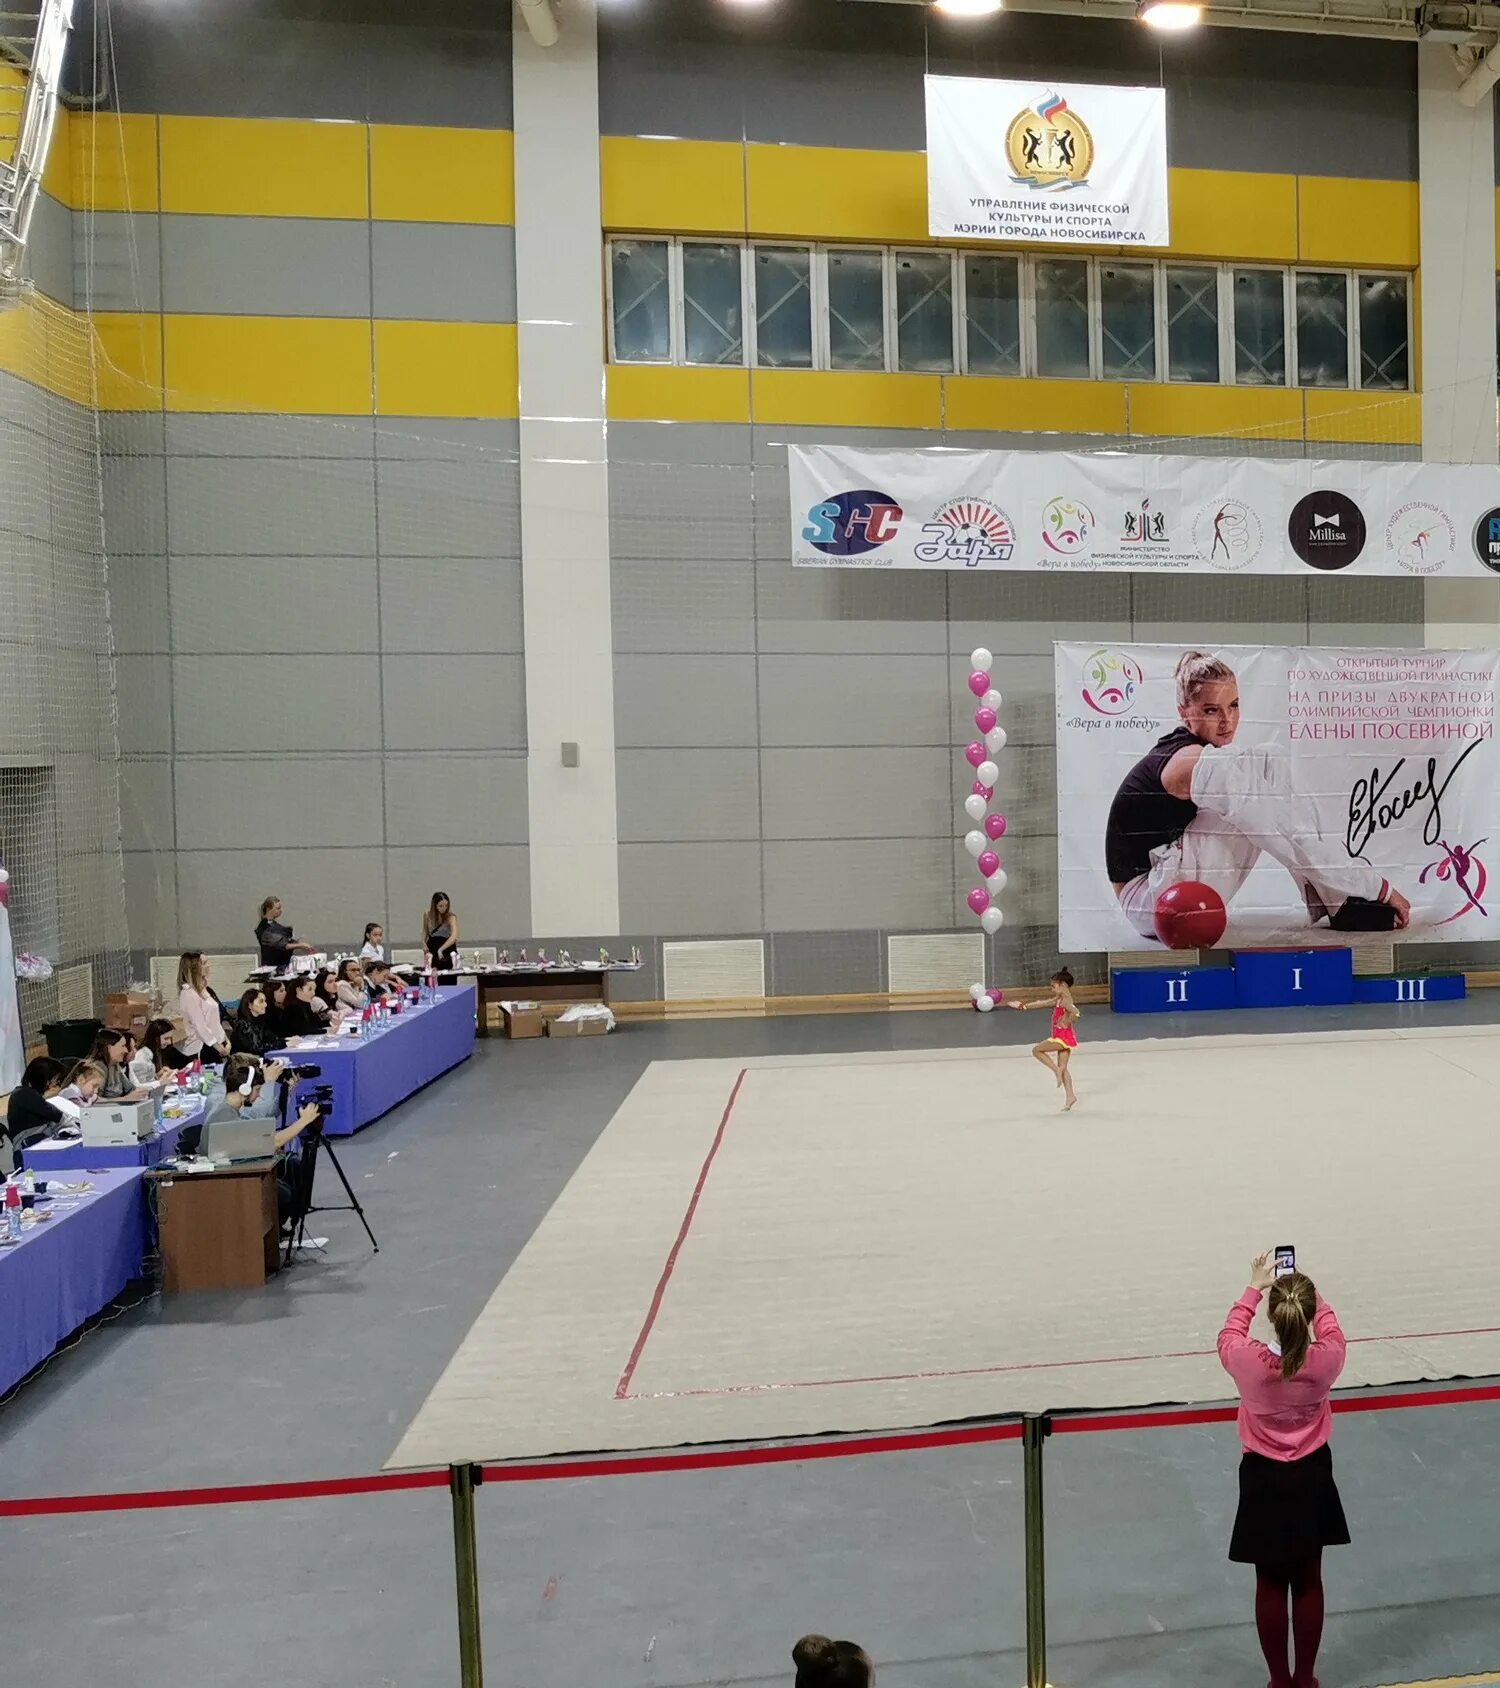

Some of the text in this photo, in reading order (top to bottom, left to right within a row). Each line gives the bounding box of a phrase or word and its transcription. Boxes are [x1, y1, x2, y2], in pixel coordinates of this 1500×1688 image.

[969, 198, 1130, 214] УПРАВЛЕНИЕ ФИЗИЧЕСКОЙ
[988, 212, 1112, 226] КУЛЬТУРЫ И СПОРТА
[953, 223, 1146, 241] МЭРИИ ГОРОДА НОВОСИБИРСКА
[1309, 528, 1347, 541] Millisa
[914, 523, 1014, 567] Заря
[1336, 656, 1447, 668] ОТКРЫТЫЙ ТУРНИР
[1287, 669, 1494, 681] ПО ХУДОЖЕСТВЕННОЙ ГИМНАСТИКЕ
[1288, 688, 1494, 703] НА ПРИЗЫ ДВУКРАТНОЙ
[1288, 704, 1494, 718] ОЛИМПИЙСКОЙ ЧЕМПИОНКИ
[1066, 716, 1161, 732] «Вера в победу»
[1289, 720, 1493, 739] ЕЛЕНЫ ПОСЕВИНОЙ
[1292, 968, 1303, 990] I
[1165, 979, 1189, 1002] II
[1395, 979, 1427, 1001] III
